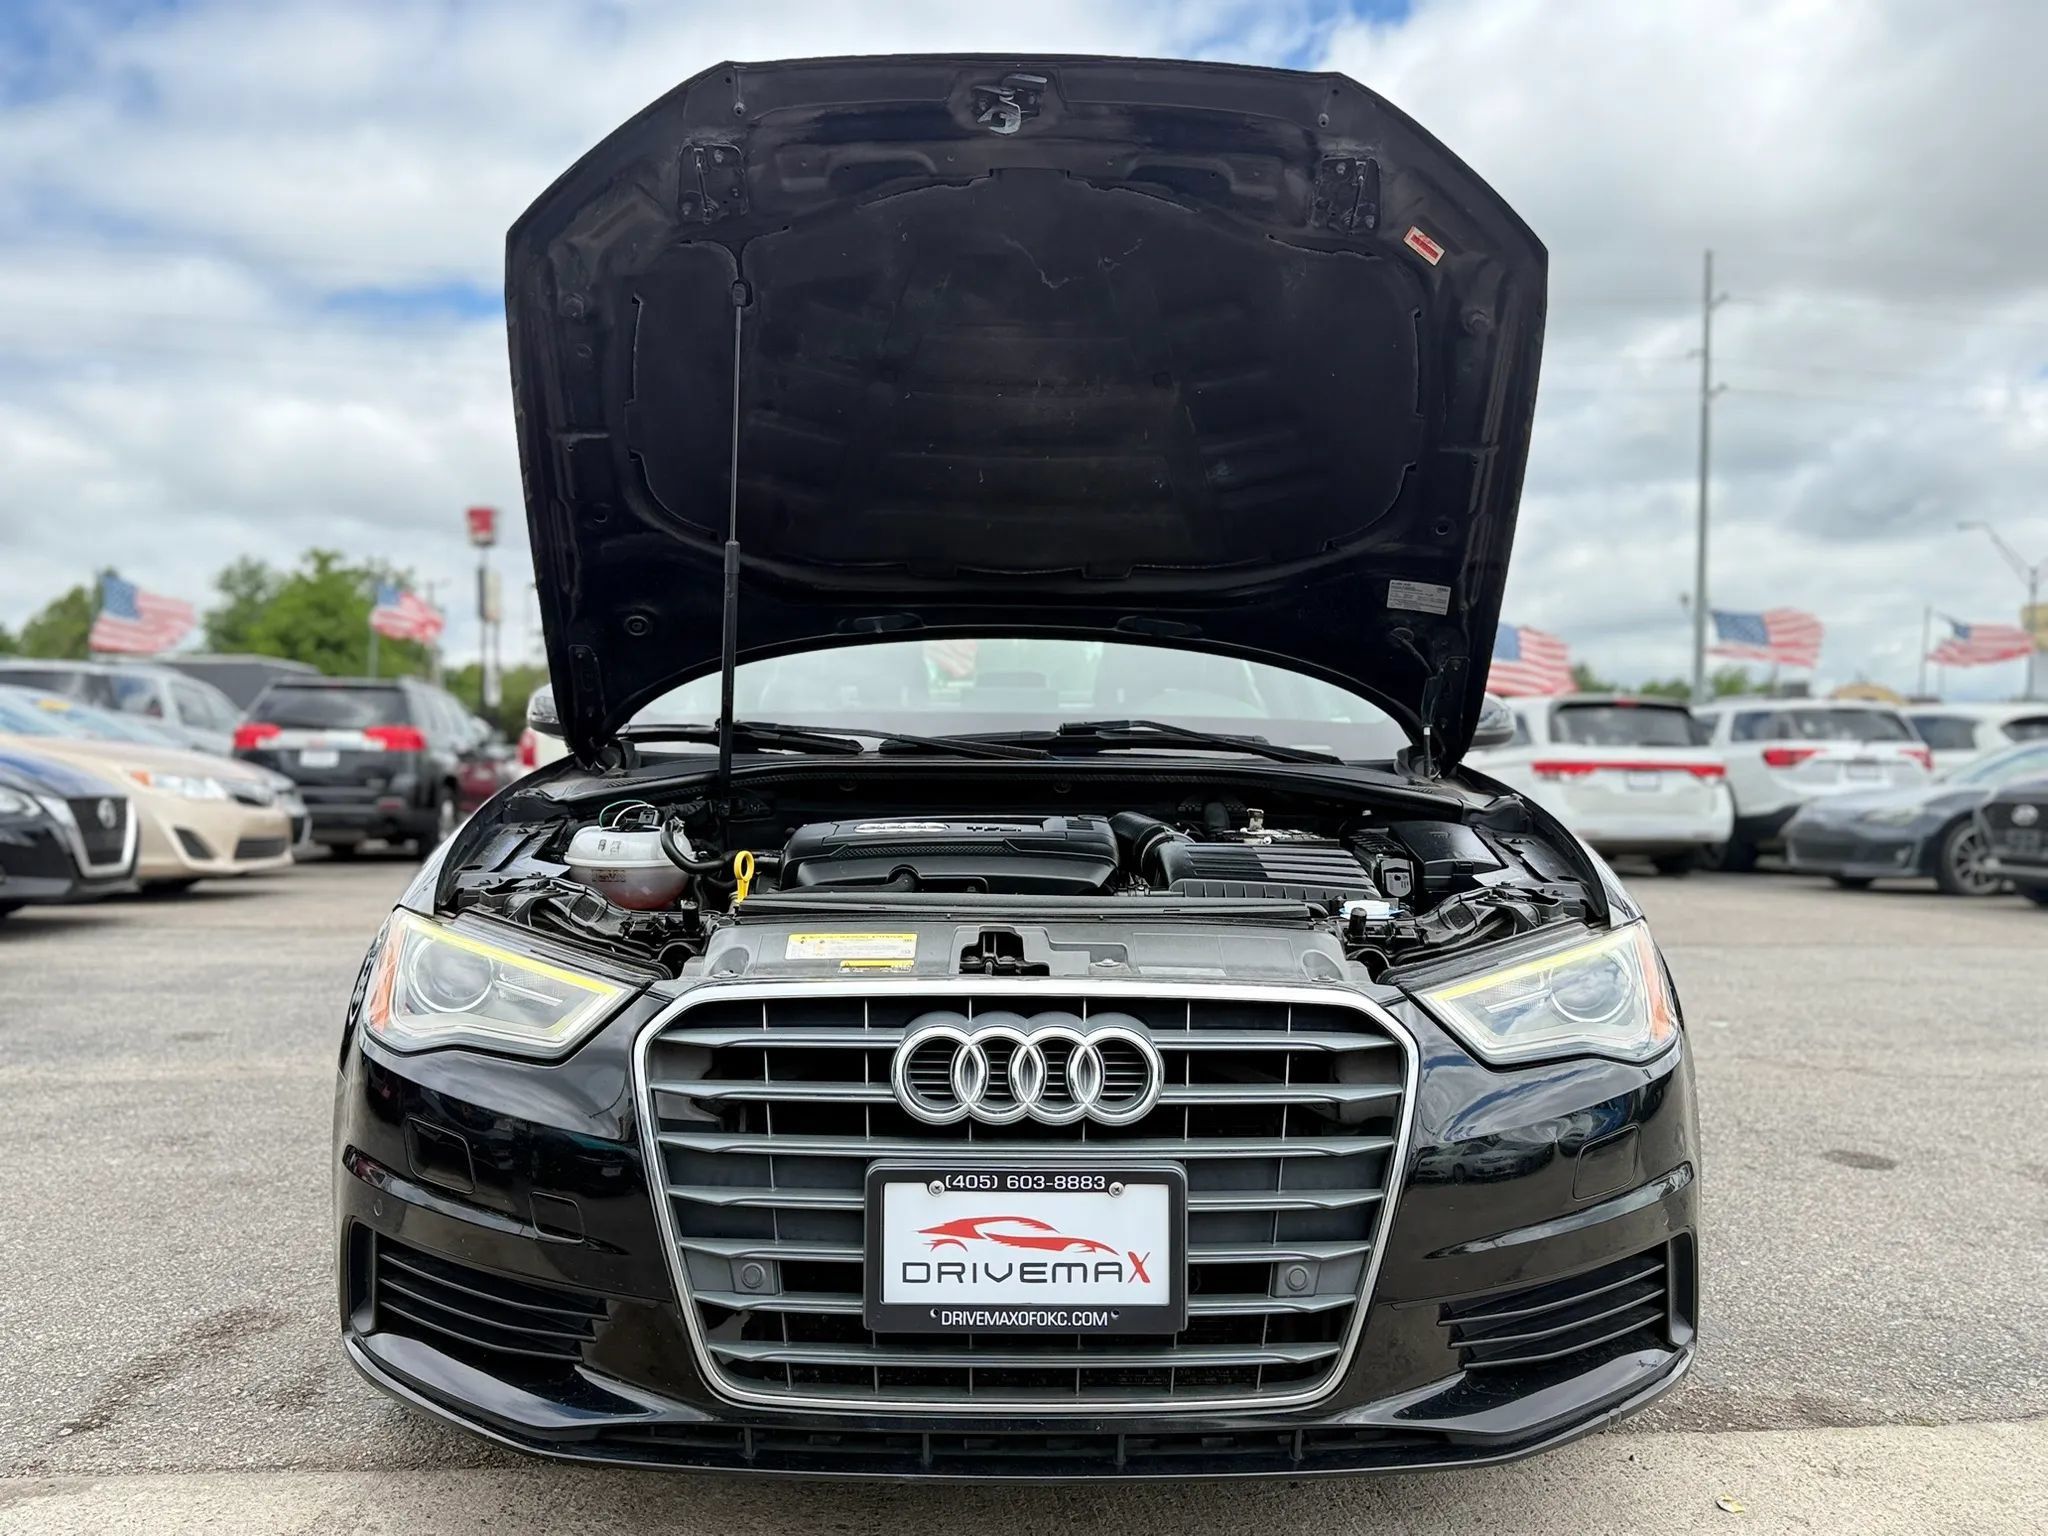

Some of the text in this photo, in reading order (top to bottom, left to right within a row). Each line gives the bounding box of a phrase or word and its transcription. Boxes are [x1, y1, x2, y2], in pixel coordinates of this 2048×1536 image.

[945, 1175, 1106, 1190] (405) 603-8883
[941, 1310, 1108, 1327] DRIVEMAXOFOKC.COM
